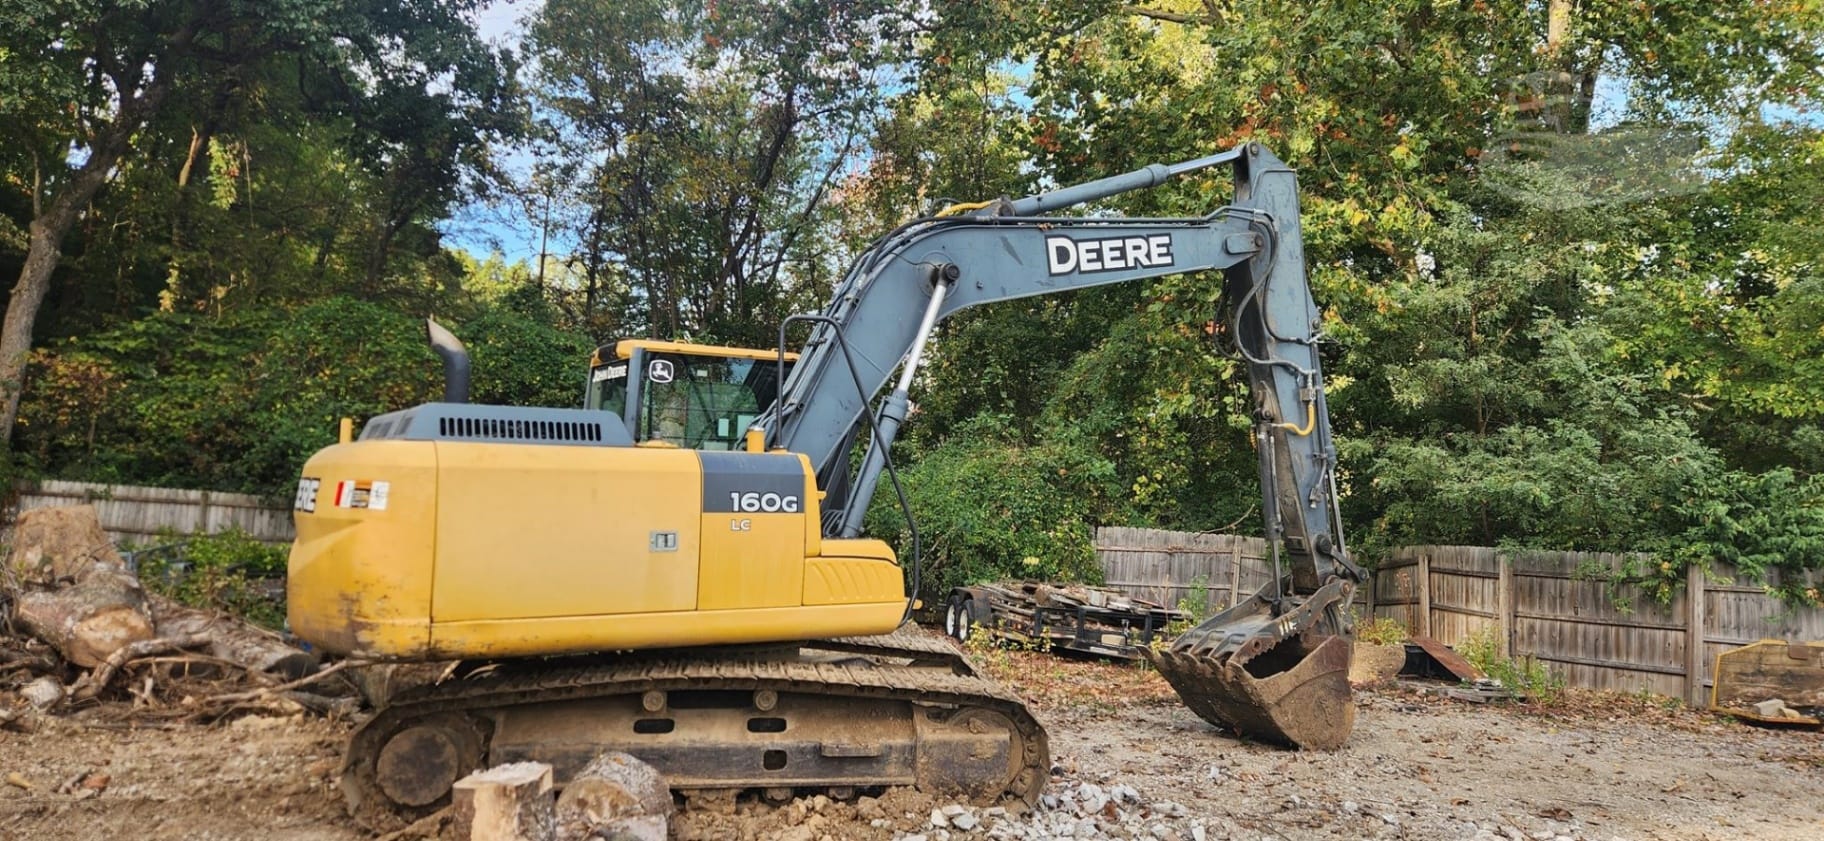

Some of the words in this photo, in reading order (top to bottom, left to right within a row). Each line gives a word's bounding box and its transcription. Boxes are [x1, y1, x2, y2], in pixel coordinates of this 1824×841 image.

[1046, 235, 1173, 275] DEERE
[730, 492, 798, 512] 160G
[731, 519, 751, 531] LC
